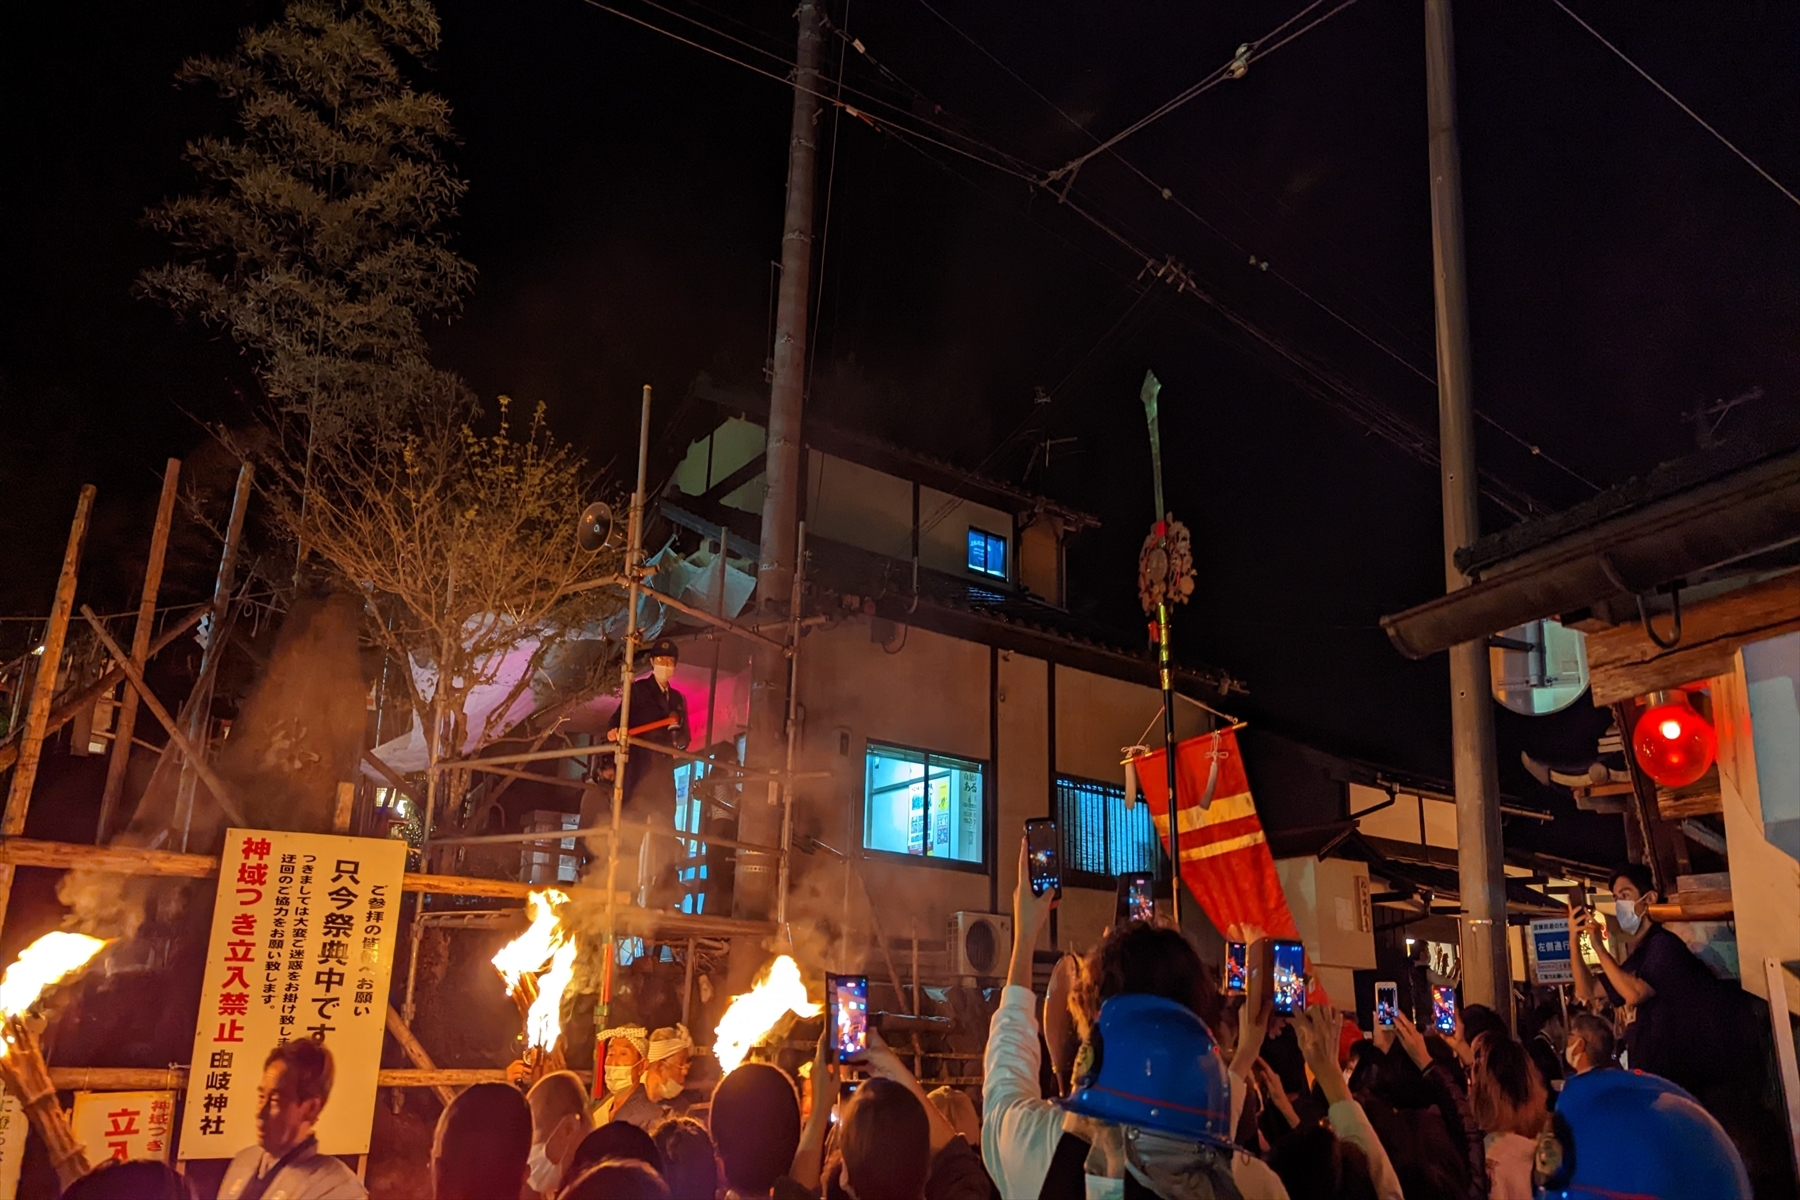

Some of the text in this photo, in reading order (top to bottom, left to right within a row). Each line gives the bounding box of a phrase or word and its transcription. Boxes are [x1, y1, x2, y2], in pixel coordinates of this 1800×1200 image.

[213, 837, 271, 1043] 神域つき立入禁止
[261, 854, 297, 1010] 迂回のご協力をお願い致します。
[307, 859, 360, 1046] 只今祭典中です
[1537, 941, 1570, 951] 左側通行
[147, 1100, 169, 1151] 神域つき
[200, 1050, 233, 1135] 由岐神社
